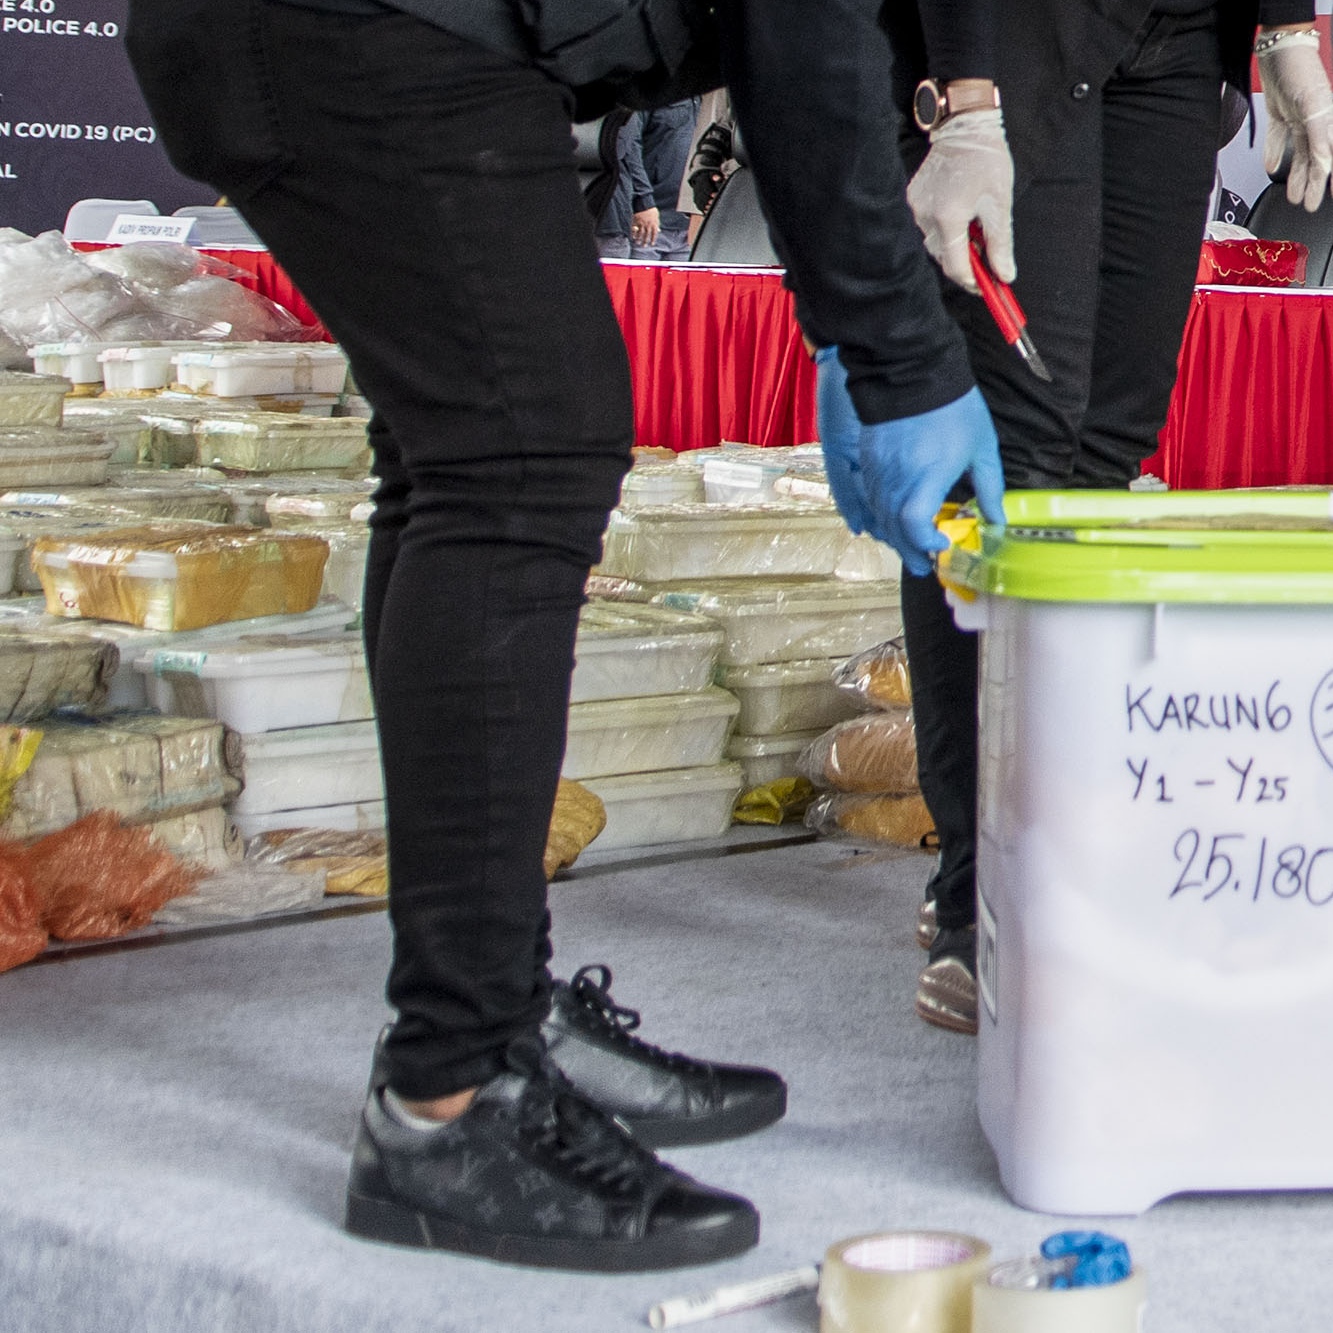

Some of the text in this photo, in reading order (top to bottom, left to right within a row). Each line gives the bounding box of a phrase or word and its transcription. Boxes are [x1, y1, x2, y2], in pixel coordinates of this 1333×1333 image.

[3, 18, 119, 38] POLICE 4.0
[15, 122, 82, 140] COVID
[84, 125, 109, 141] 19
[113, 125, 156, 143] (PC)
